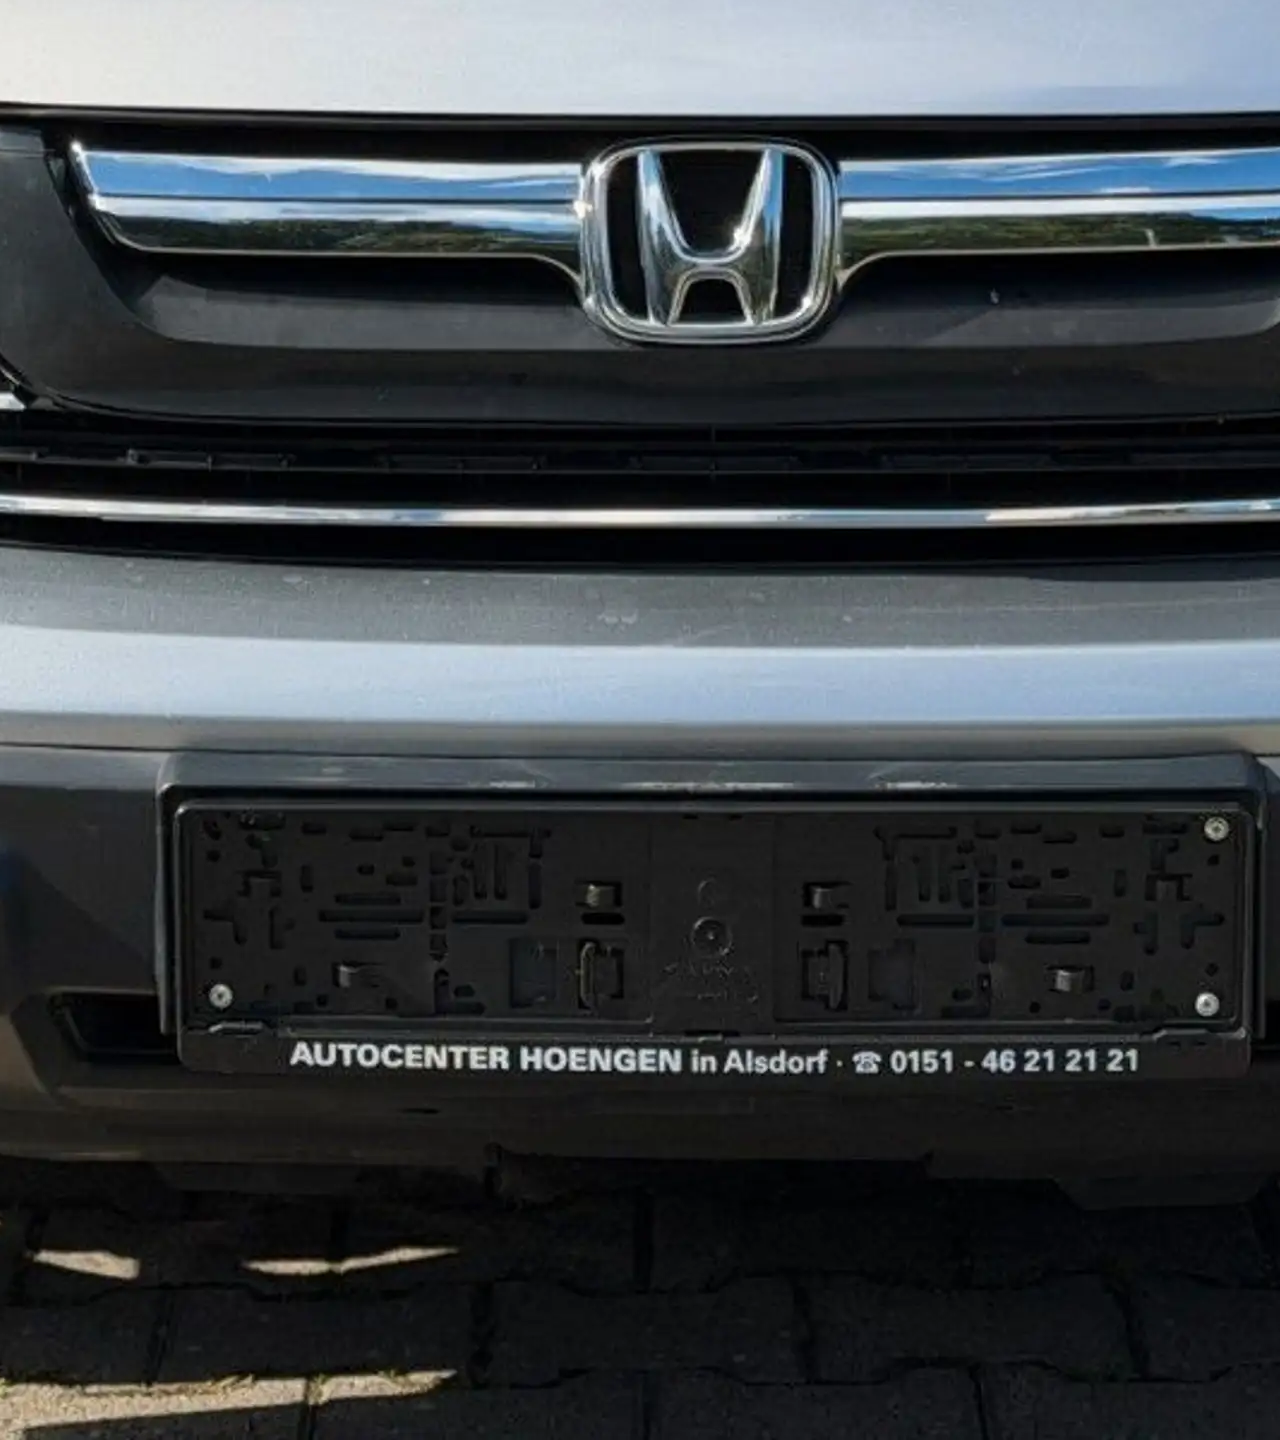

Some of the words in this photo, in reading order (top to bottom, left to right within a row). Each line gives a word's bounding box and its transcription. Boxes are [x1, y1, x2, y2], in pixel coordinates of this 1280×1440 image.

[289, 1041, 510, 1070] AUTOCENTER
[519, 1046, 682, 1073] HOENGEN
[691, 1048, 718, 1073] in
[723, 1048, 829, 1074] Alsdorf
[890, 1049, 953, 1074] 0151
[981, 1049, 1016, 1073] 46
[1023, 1049, 1055, 1072] 21
[1065, 1048, 1096, 1072] 21
[1106, 1048, 1138, 1072] 21
